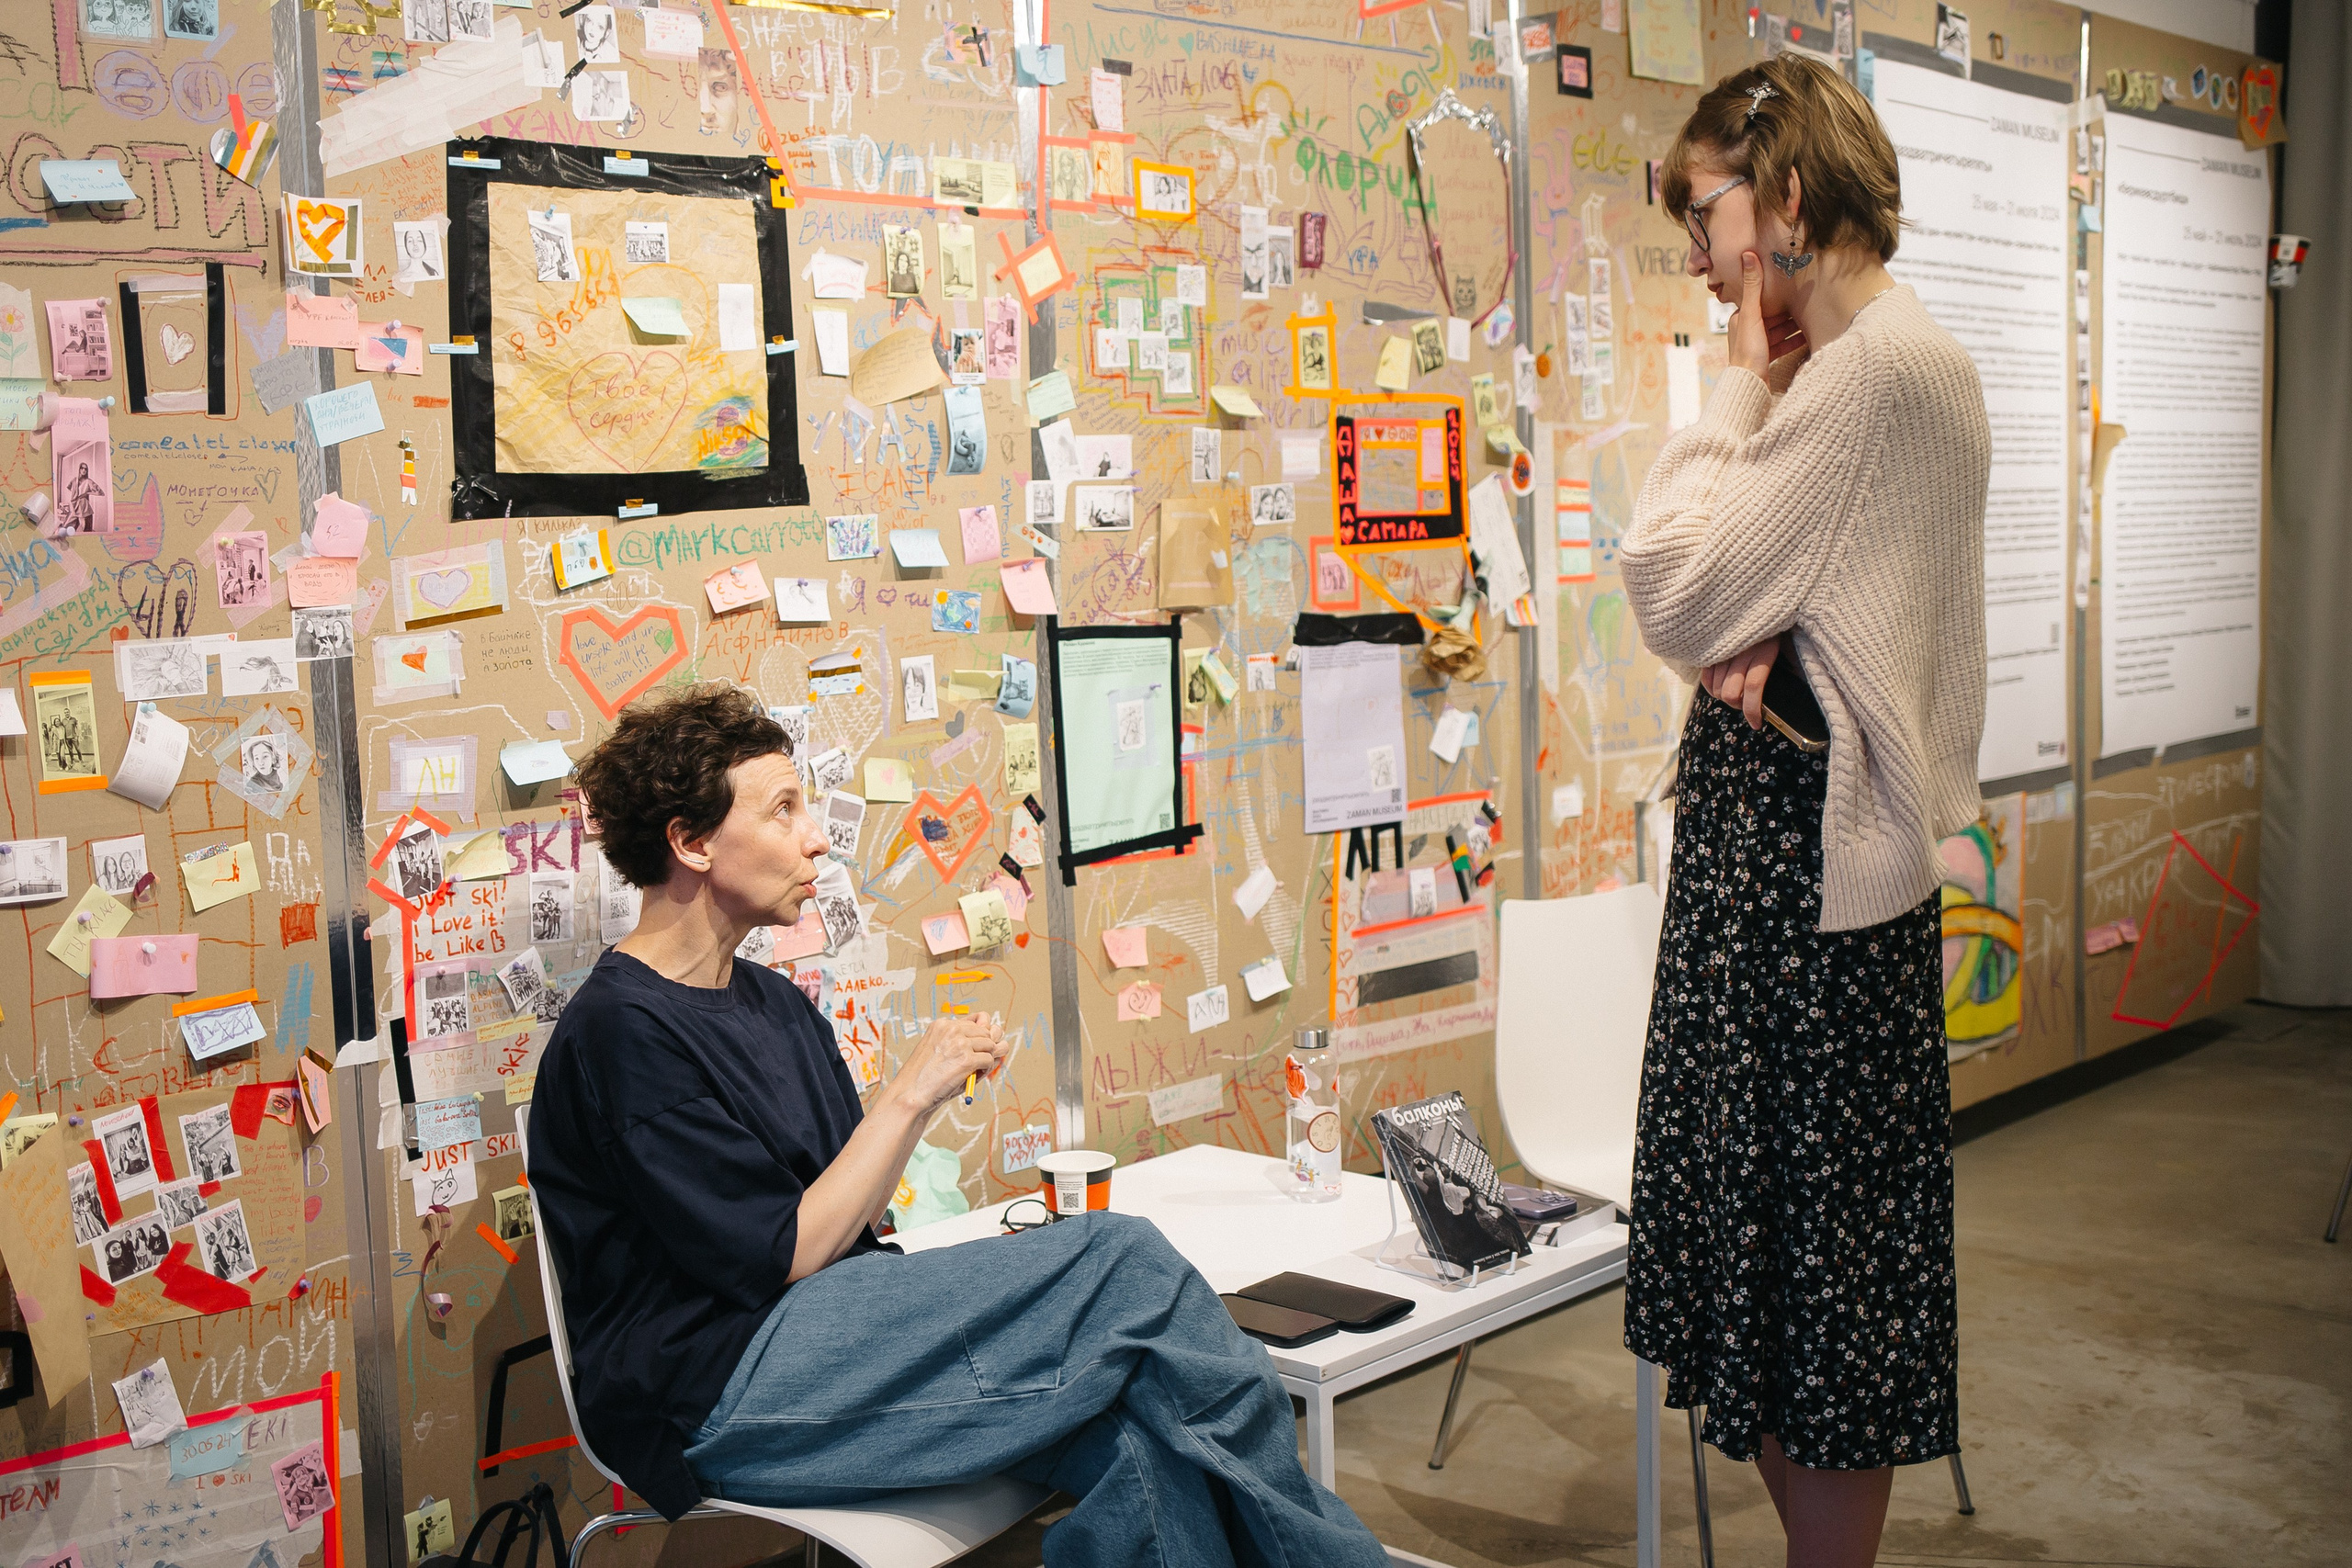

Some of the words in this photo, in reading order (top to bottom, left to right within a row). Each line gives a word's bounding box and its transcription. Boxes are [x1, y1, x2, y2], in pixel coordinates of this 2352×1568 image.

[167, 482, 260, 499] МОНЕТОЧКА
[573, 634, 597, 653] love
[1346, 807, 1371, 819] ZAMAN
[1372, 805, 1403, 817] MUSEUM
[506, 807, 582, 875] SKI
[432, 914, 473, 934] Love
[415, 943, 435, 963] be
[447, 934, 485, 956] Like
[1390, 1096, 1464, 1127] балконы
[421, 1140, 474, 1172] JUST
[231, 1473, 253, 1485] SKI
